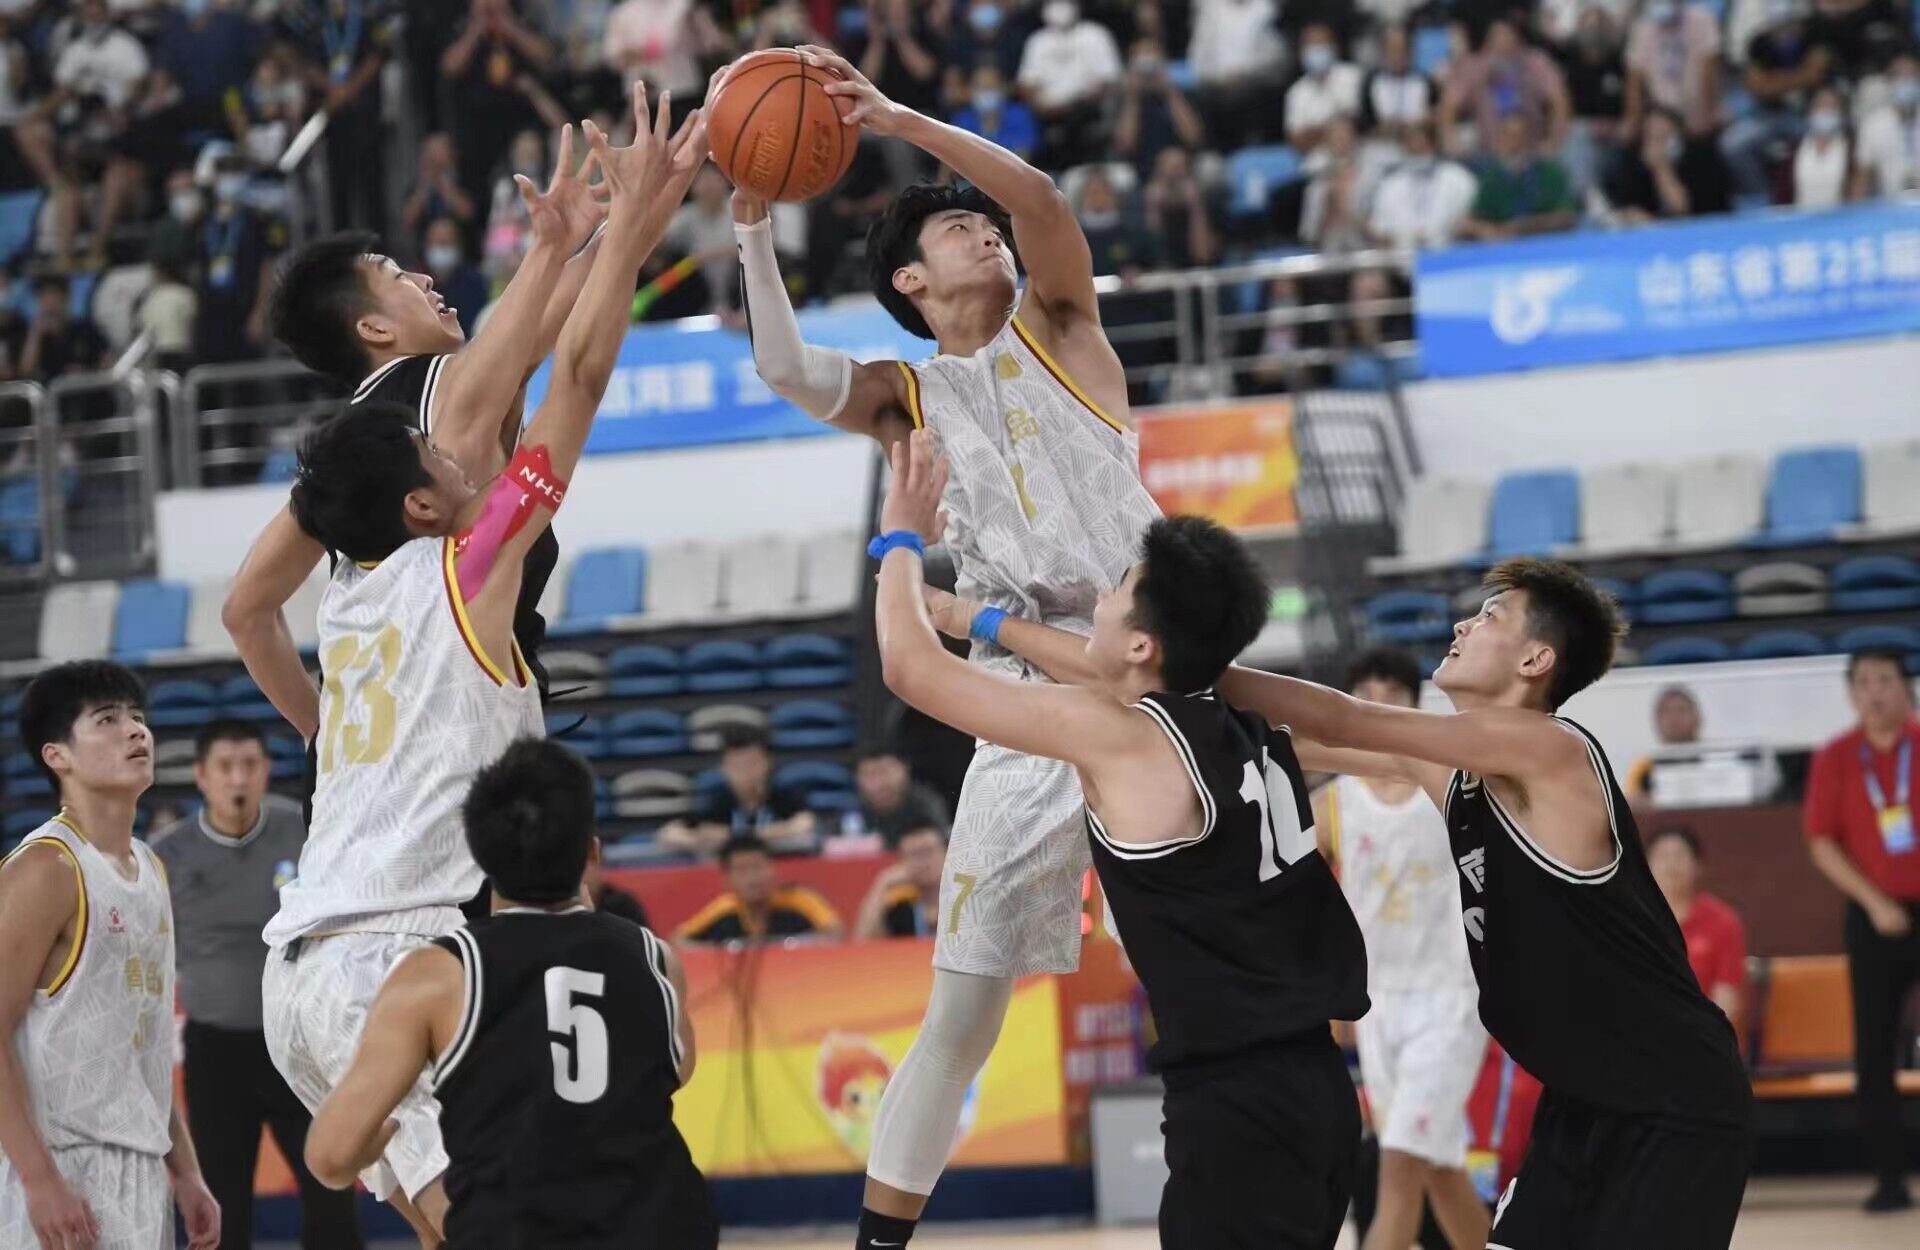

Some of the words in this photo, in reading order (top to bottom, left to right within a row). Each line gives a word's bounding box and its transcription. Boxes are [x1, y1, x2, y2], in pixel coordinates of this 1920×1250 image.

[321, 624, 404, 773] 13
[947, 872, 977, 934] 7
[543, 965, 609, 1104] 5
